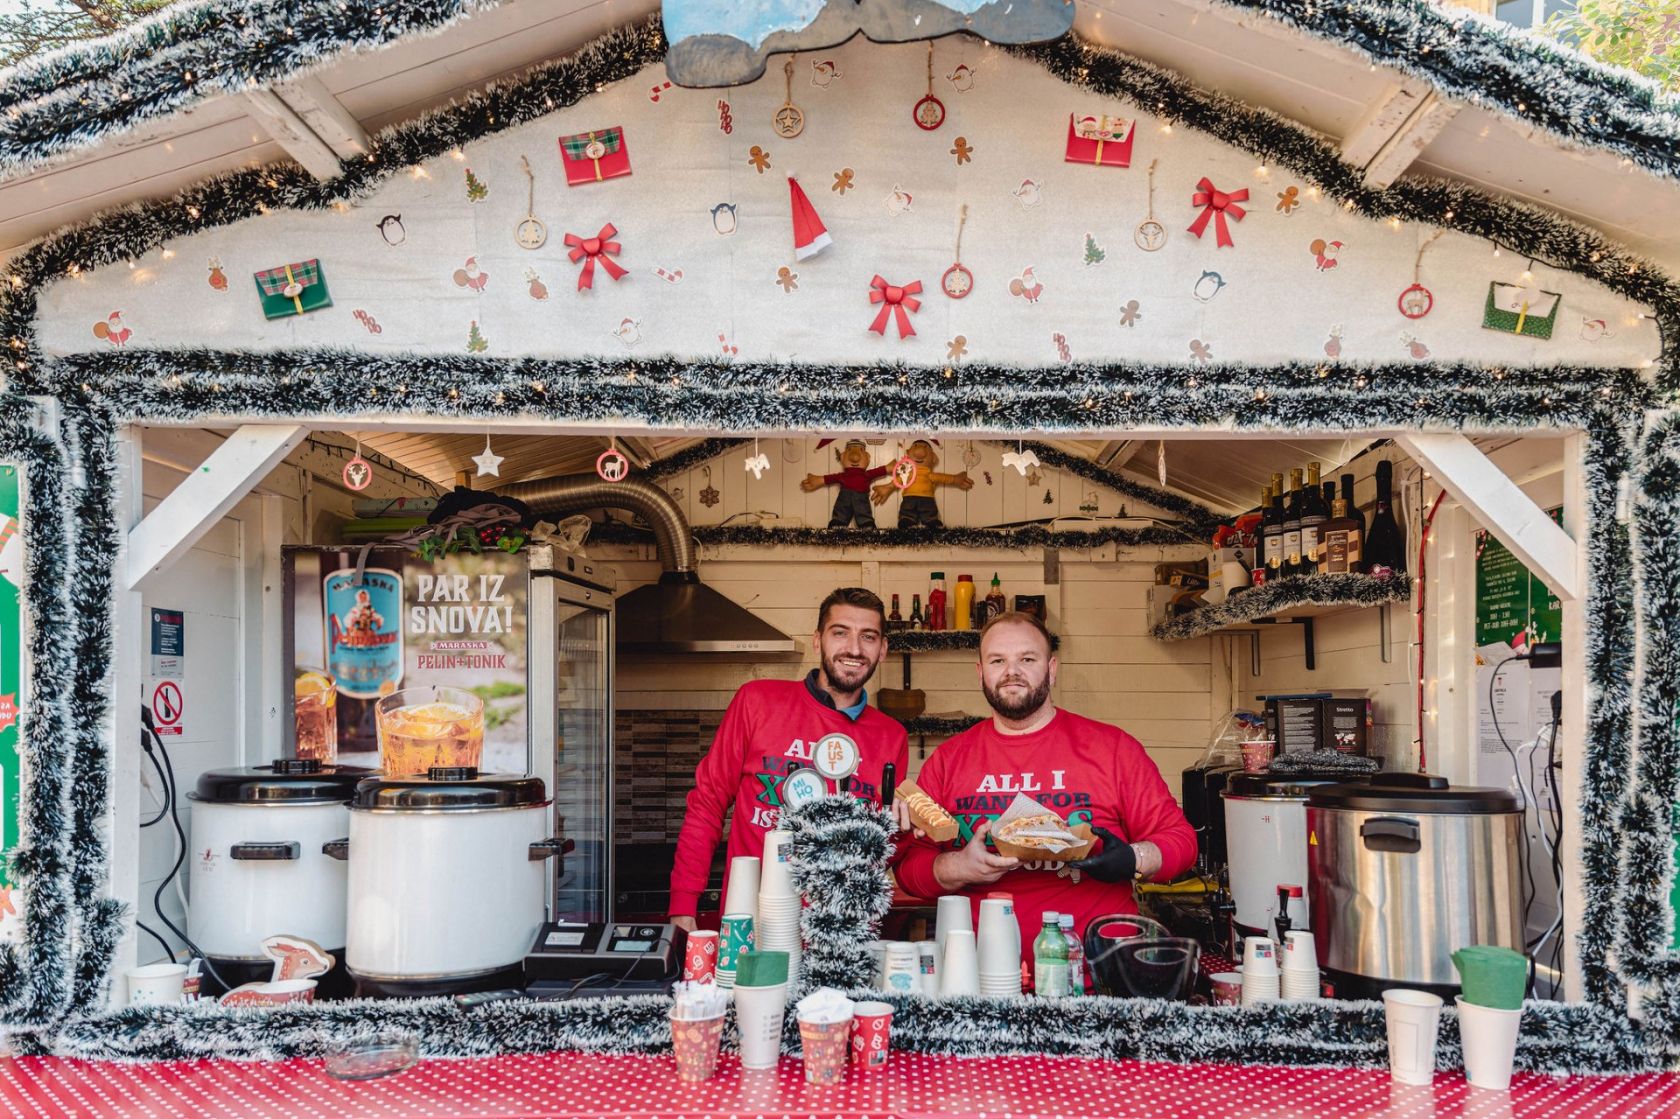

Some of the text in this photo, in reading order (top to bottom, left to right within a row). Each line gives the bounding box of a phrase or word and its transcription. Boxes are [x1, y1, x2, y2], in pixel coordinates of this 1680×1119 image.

[417, 574, 505, 602] PAR IZ
[411, 606, 513, 633] SNOVA!
[417, 655, 506, 669] PELIN+TONIK
[828, 741, 842, 750] FA
[828, 751, 843, 761] US
[829, 761, 837, 771] T
[792, 778, 806, 791] MI
[976, 770, 1065, 793] ALL I
[1035, 792, 1092, 809] FOR
